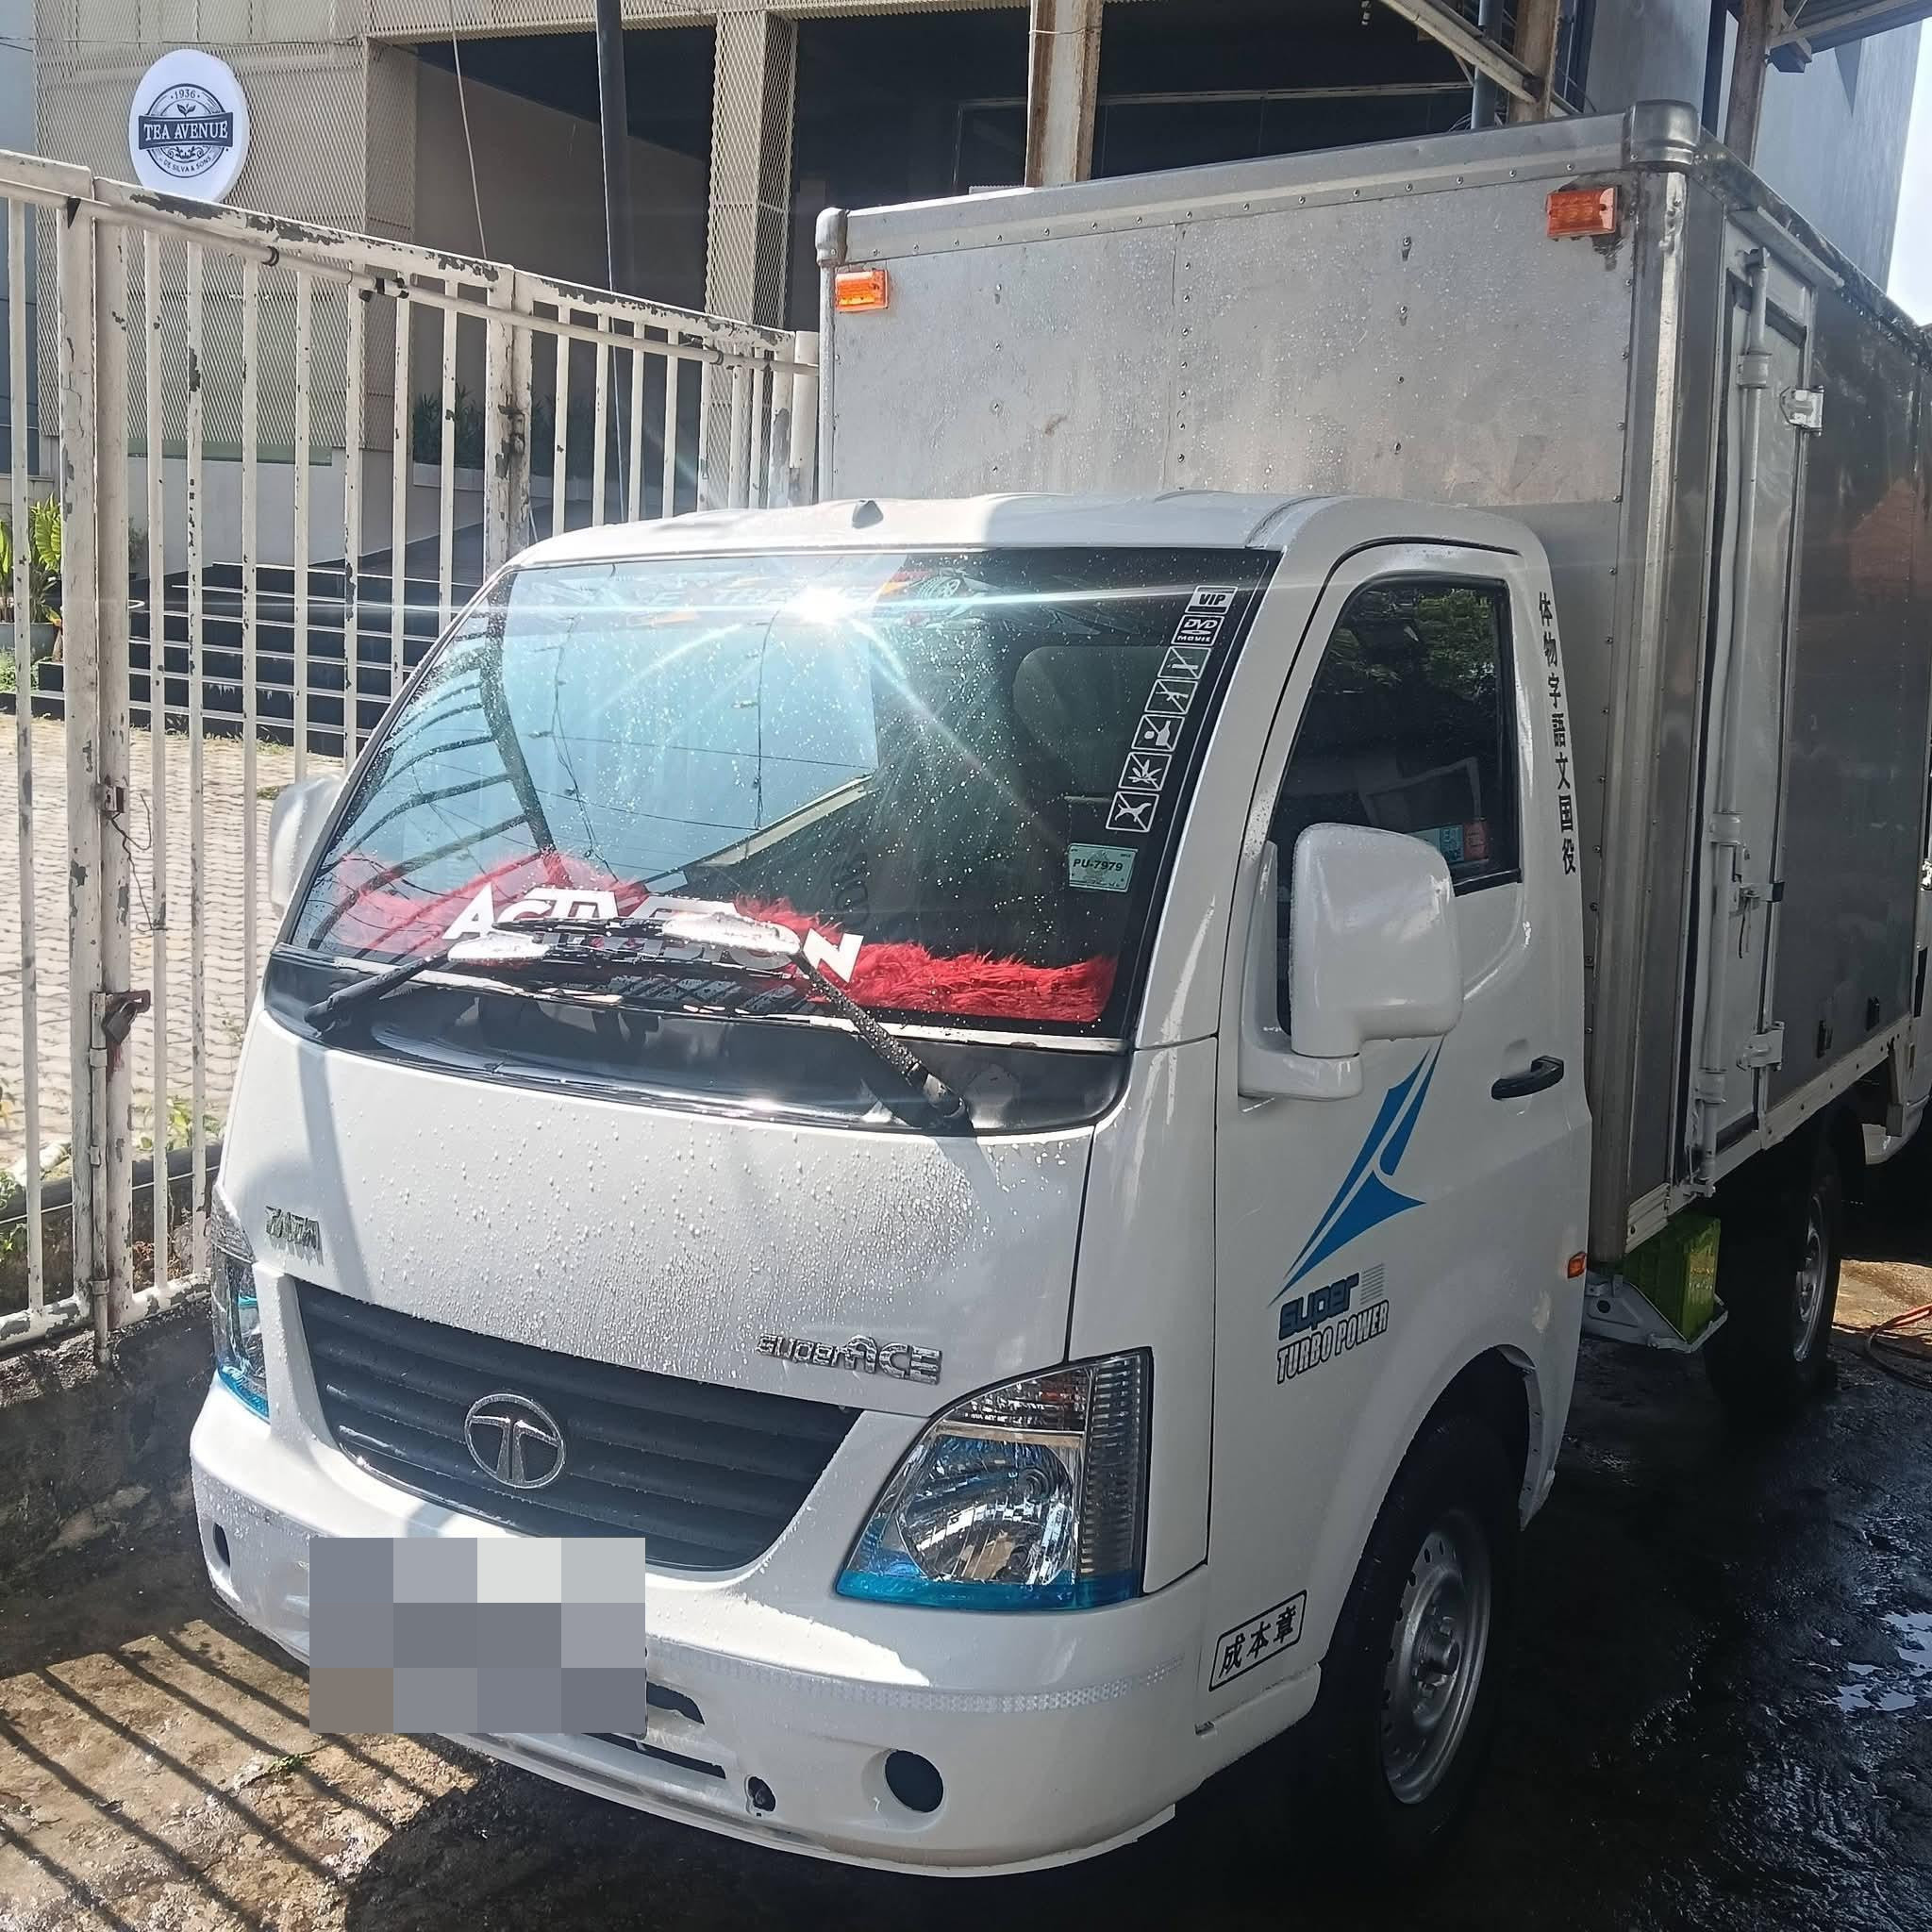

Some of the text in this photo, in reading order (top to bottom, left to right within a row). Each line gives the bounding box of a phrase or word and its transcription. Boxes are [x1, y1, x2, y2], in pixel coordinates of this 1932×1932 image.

[175, 89, 196, 99] 1936
[143, 120, 228, 141] TEA AVENUE
[163, 159, 172, 169] DE
[172, 163, 190, 173] SILVA
[195, 156, 212, 169] SONS
[1198, 593, 1226, 606] VIP
[1184, 619, 1218, 630] DVD
[1073, 858, 1124, 872] PU-7979
[1276, 1299, 1390, 1385] TURBO POWER
